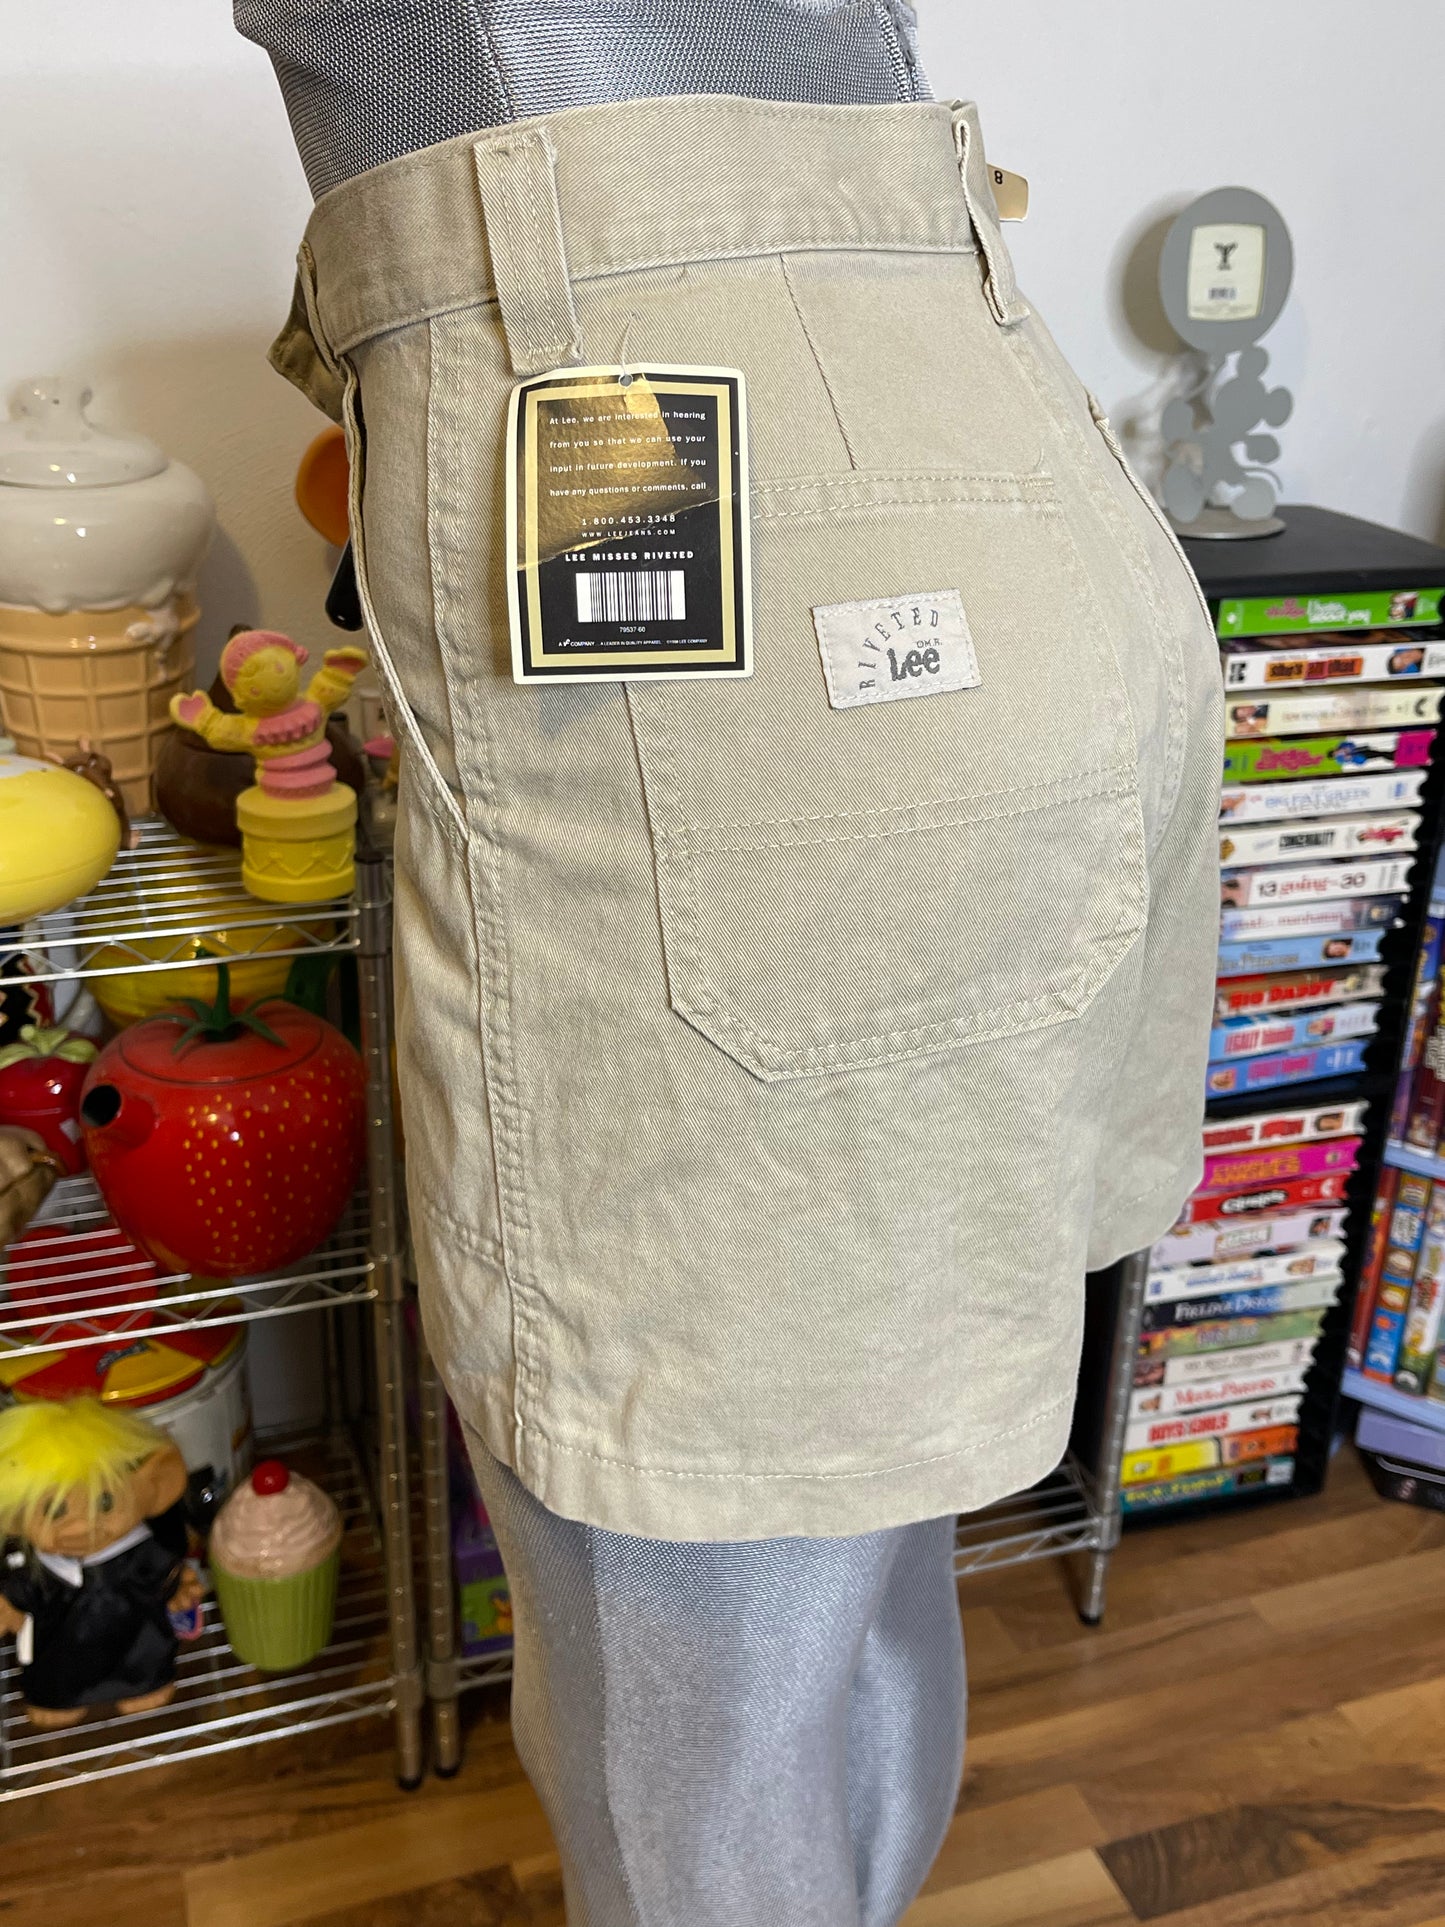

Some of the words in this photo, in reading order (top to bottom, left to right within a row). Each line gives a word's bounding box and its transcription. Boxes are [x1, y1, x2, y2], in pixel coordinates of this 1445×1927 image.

[995, 170, 1003, 185] 8
[549, 417, 558, 425] At
[615, 412, 659, 420] interested
[673, 411, 706, 420] hearing
[549, 441, 570, 449] from
[573, 441, 590, 449] you
[685, 435, 706, 443] your
[549, 464, 572, 473] input
[617, 459, 677, 469] development.
[681, 458, 688, 466] If
[690, 458, 706, 467] you
[588, 486, 629, 495] questions
[642, 483, 688, 492] comments,
[565, 553, 586, 562] LEE
[592, 552, 638, 561] MISSES
[644, 551, 694, 560] RIVETED
[858, 607, 939, 690] RIVETED
[886, 647, 940, 681] Lee
